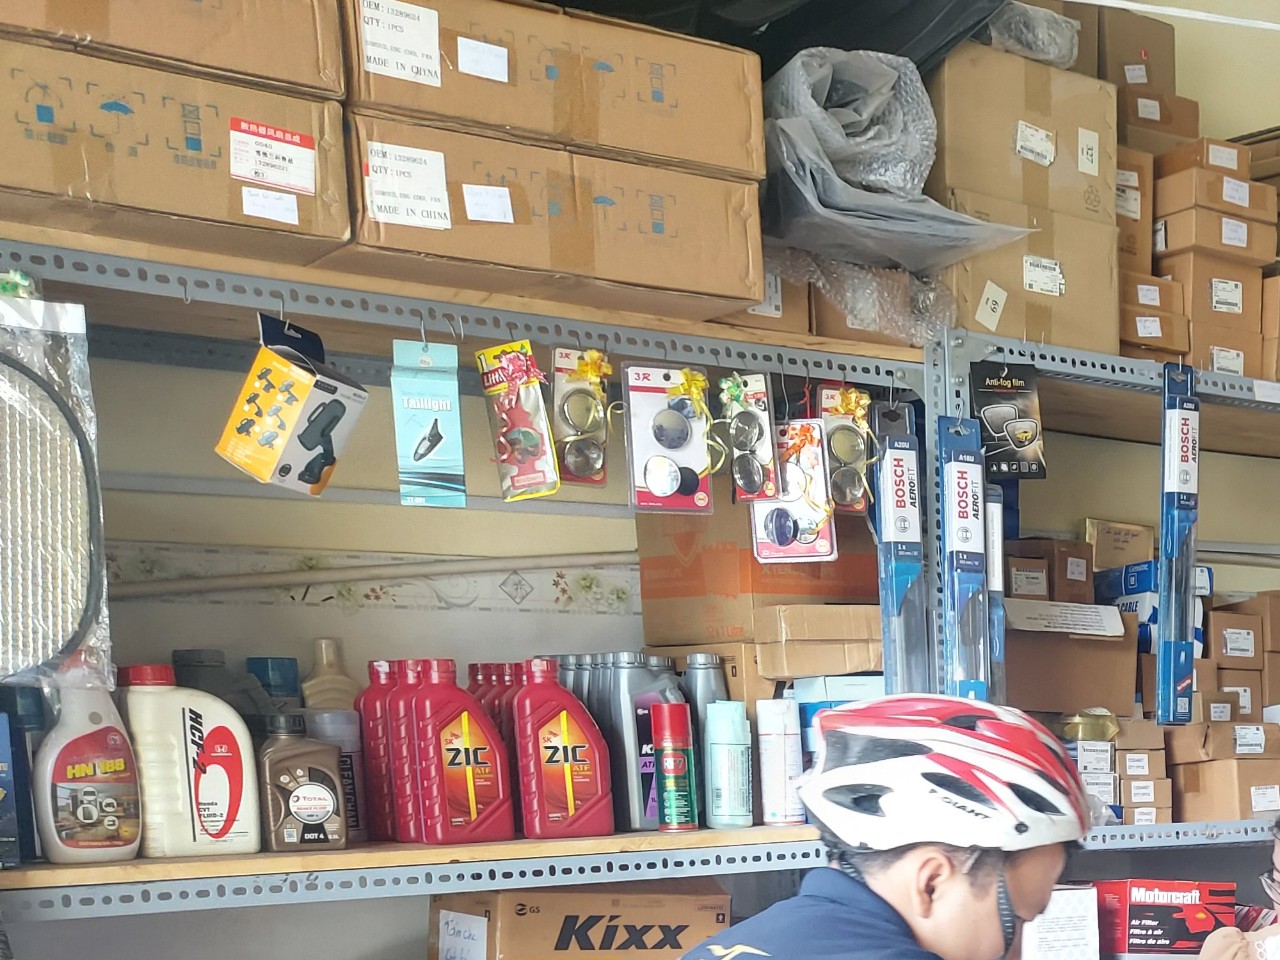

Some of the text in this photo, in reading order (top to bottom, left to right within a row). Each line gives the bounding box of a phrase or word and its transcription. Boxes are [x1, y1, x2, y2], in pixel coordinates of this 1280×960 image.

[366, 55, 439, 80] MADE IN CHINA
[1086, 144, 1094, 164] 327
[372, 165, 393, 178] QTY:
[376, 204, 449, 221] MADE IN CHINA
[635, 373, 651, 382] 3R
[985, 377, 1025, 388] Anti-fog film
[402, 397, 452, 412] Taillight
[1181, 417, 1190, 463] BOSCH
[894, 458, 906, 509] BOSCH
[908, 467, 918, 508] AEROFIT
[958, 471, 968, 520] BOSCH
[971, 480, 981, 520] AEROFIT
[188, 708, 207, 775] HCF-2
[445, 747, 489, 767] ZIC
[543, 744, 589, 765] ZIC
[1131, 887, 1201, 905] Motorcraft
[530, 906, 541, 914] GS
[554, 915, 690, 951] Kixx
